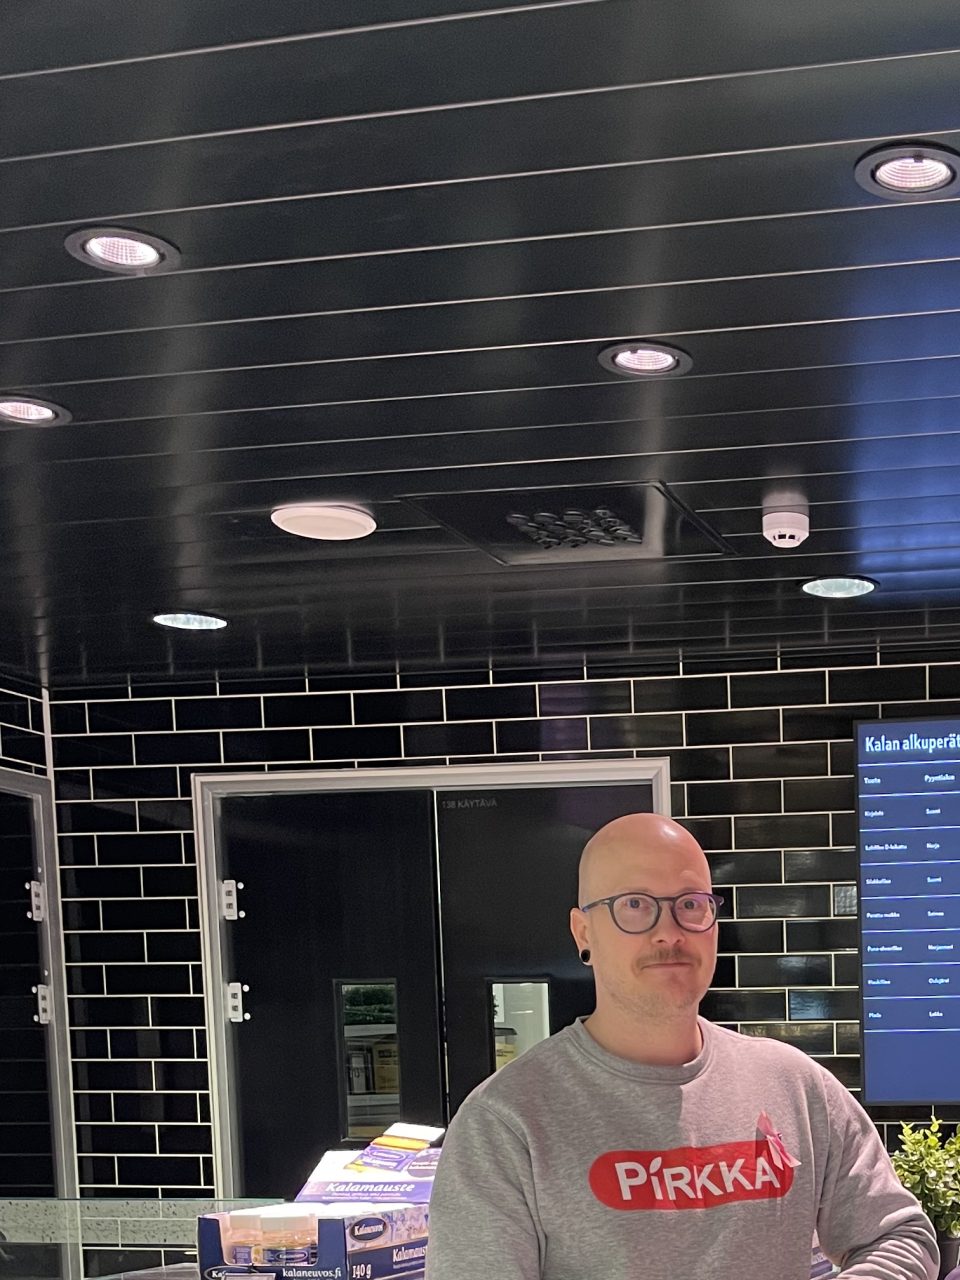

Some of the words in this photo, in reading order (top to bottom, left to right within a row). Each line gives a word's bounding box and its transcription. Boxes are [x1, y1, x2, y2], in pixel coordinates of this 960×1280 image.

[865, 735, 900, 752] Kalan
[325, 1182, 415, 1192] Kalamauste
[282, 1267, 342, 1278] kalaneuvos.fi
[352, 1264, 366, 1278] 140
[366, 1264, 372, 1279] g
